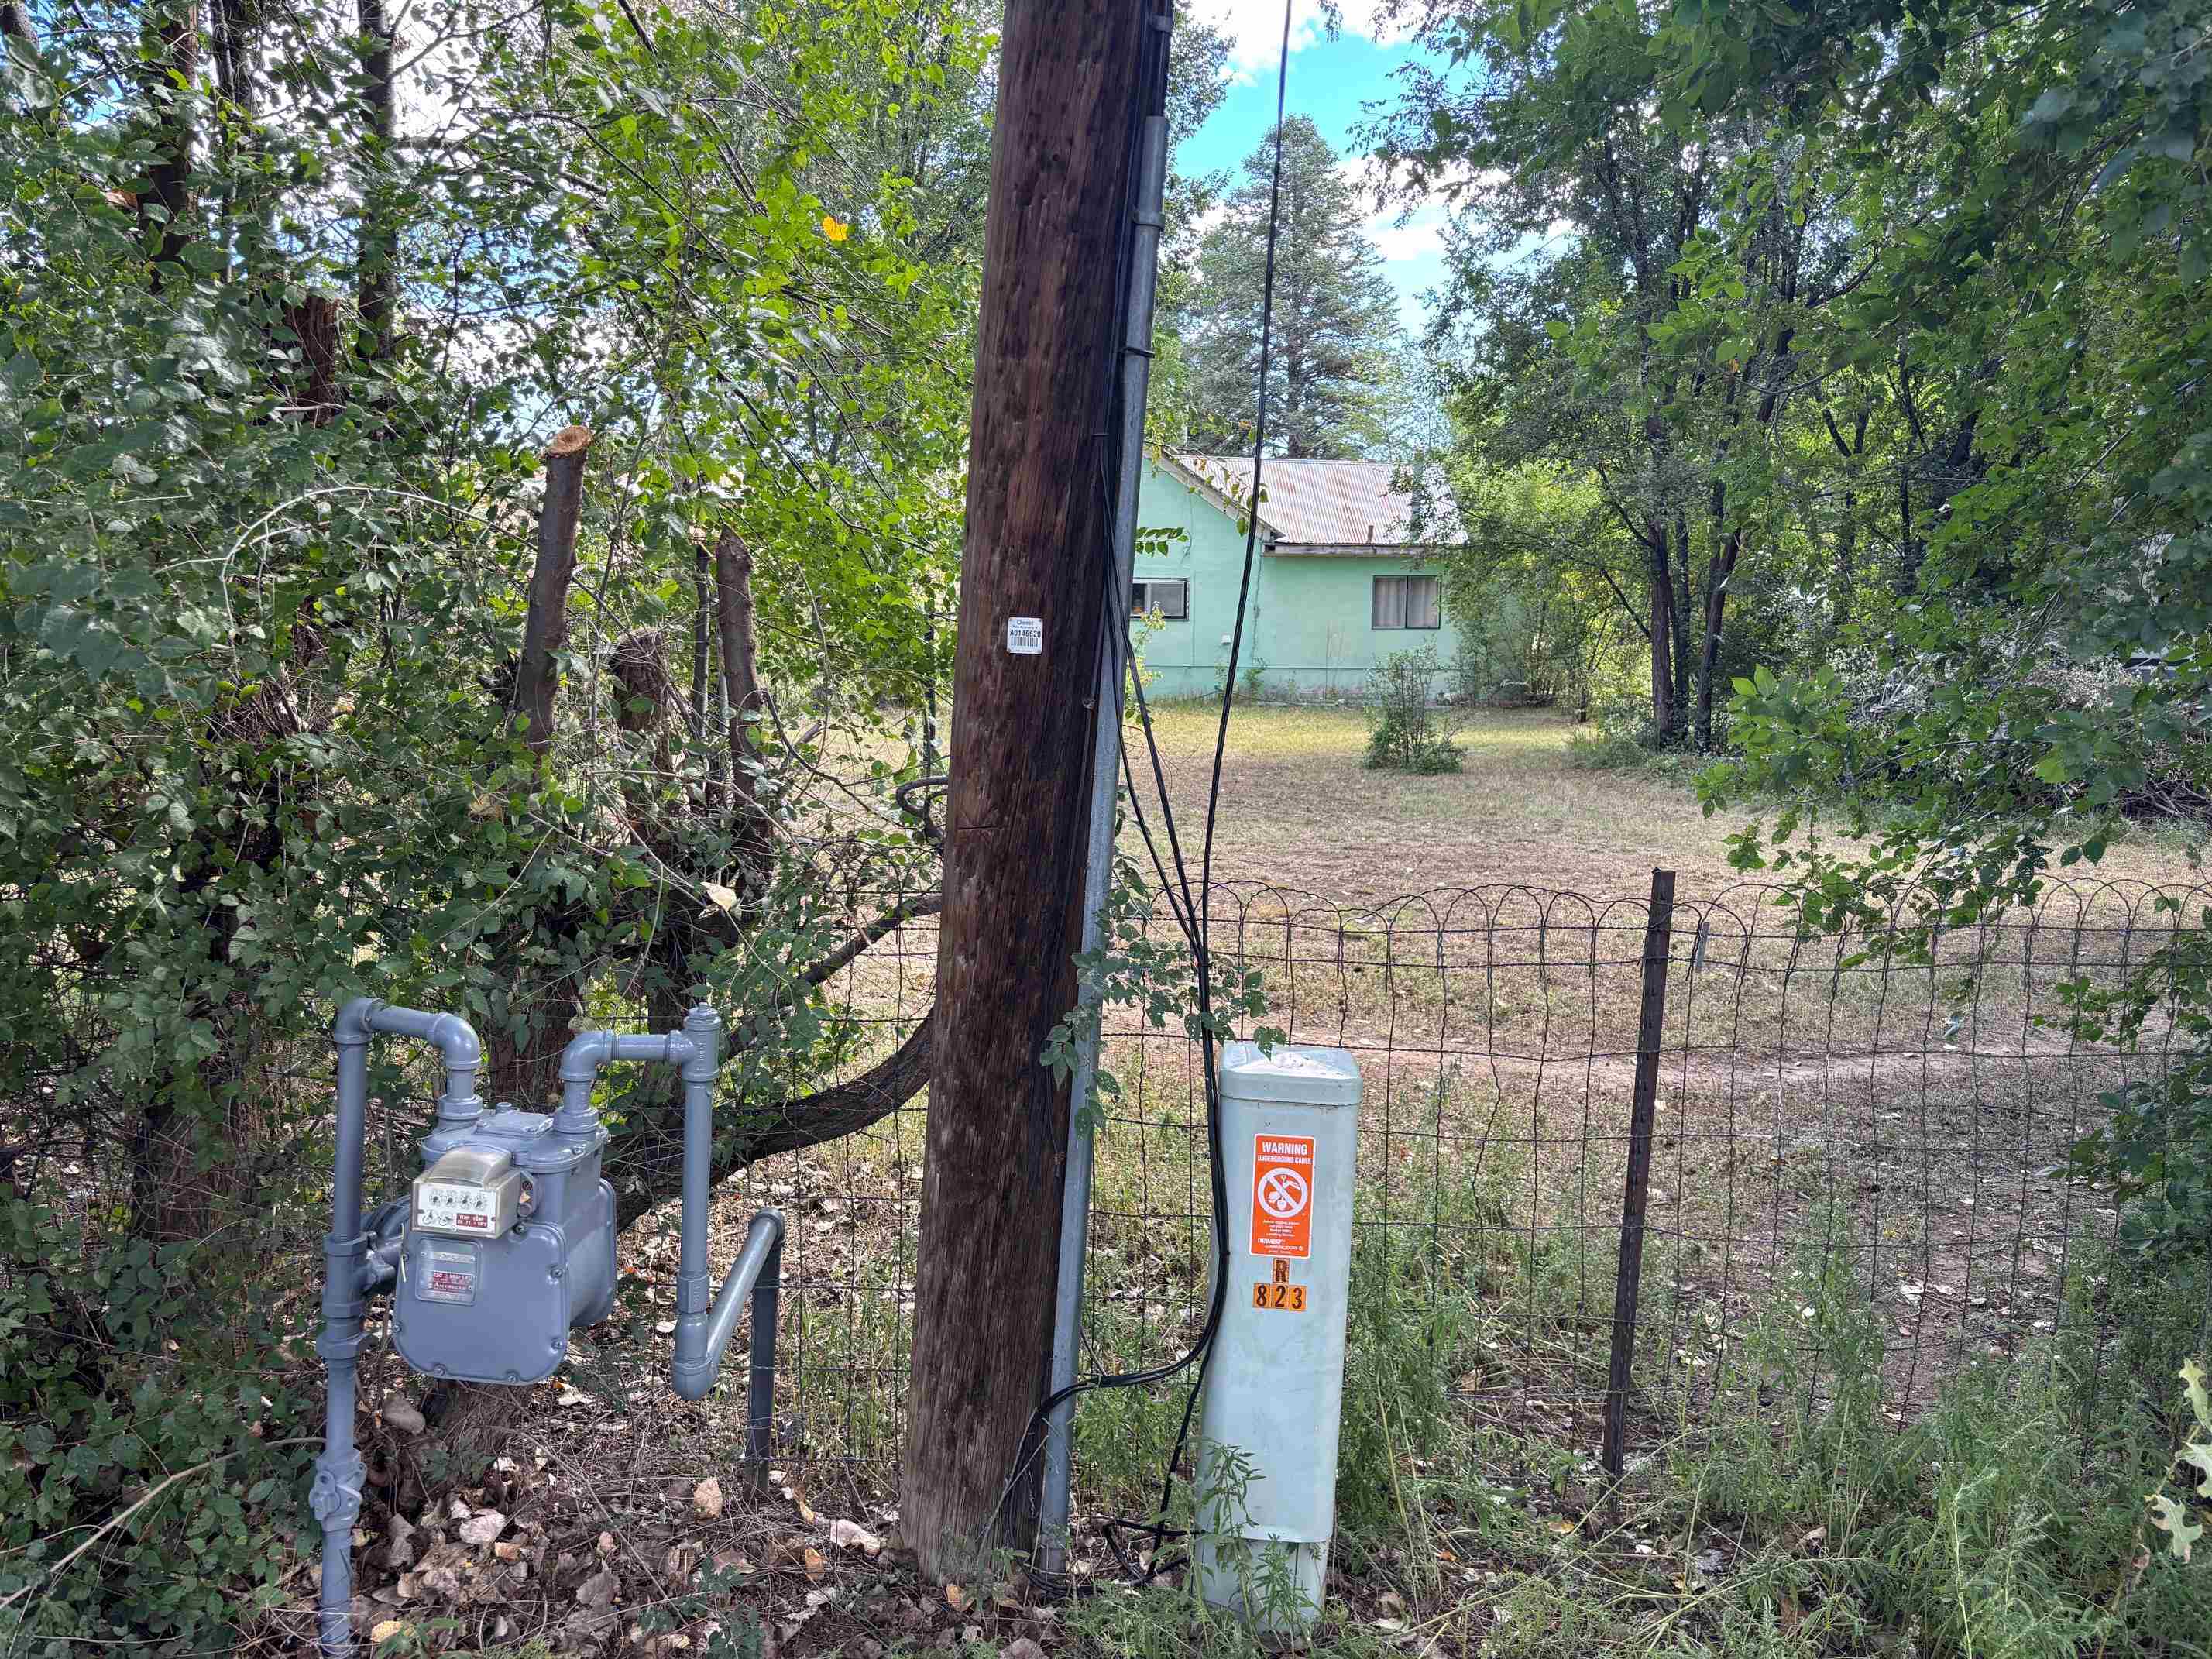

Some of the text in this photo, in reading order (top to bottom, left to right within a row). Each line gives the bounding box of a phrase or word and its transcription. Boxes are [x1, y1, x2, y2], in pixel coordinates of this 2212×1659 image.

[1262, 1141, 1308, 1156] WARNING
[1276, 1259, 1286, 1283] R
[1256, 1285, 1303, 1309] 823
